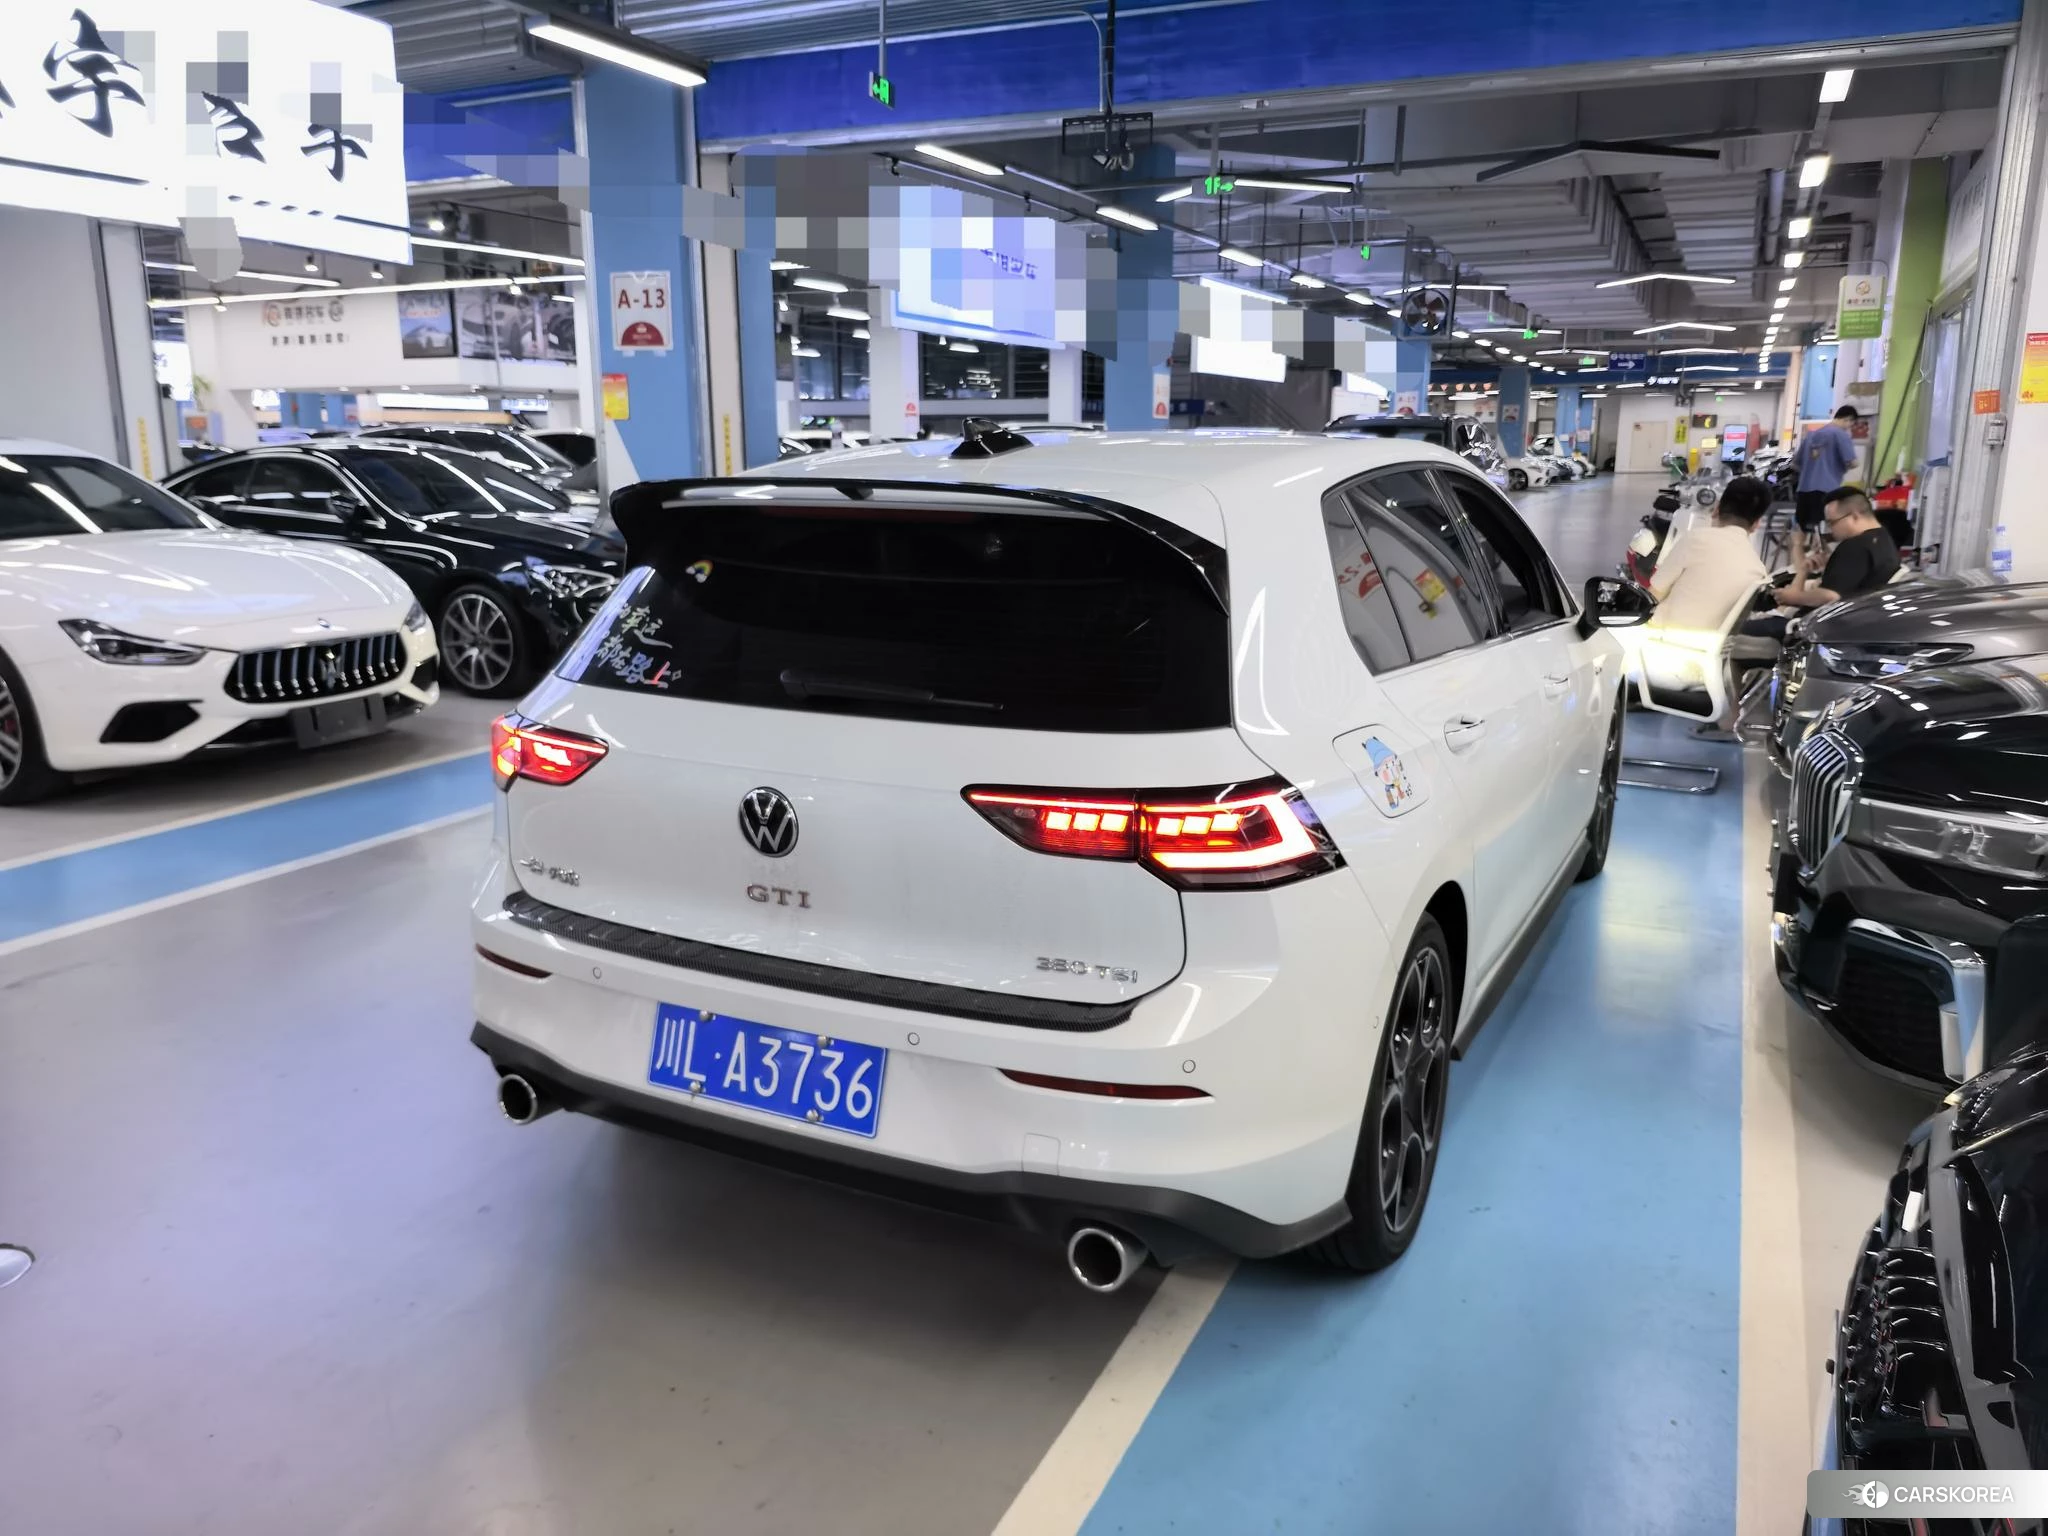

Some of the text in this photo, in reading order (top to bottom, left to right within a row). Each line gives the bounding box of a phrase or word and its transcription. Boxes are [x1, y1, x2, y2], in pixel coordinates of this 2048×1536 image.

[617, 288, 665, 309] A-13
[746, 884, 812, 909] GTI
[1095, 965, 1138, 984] TSI
